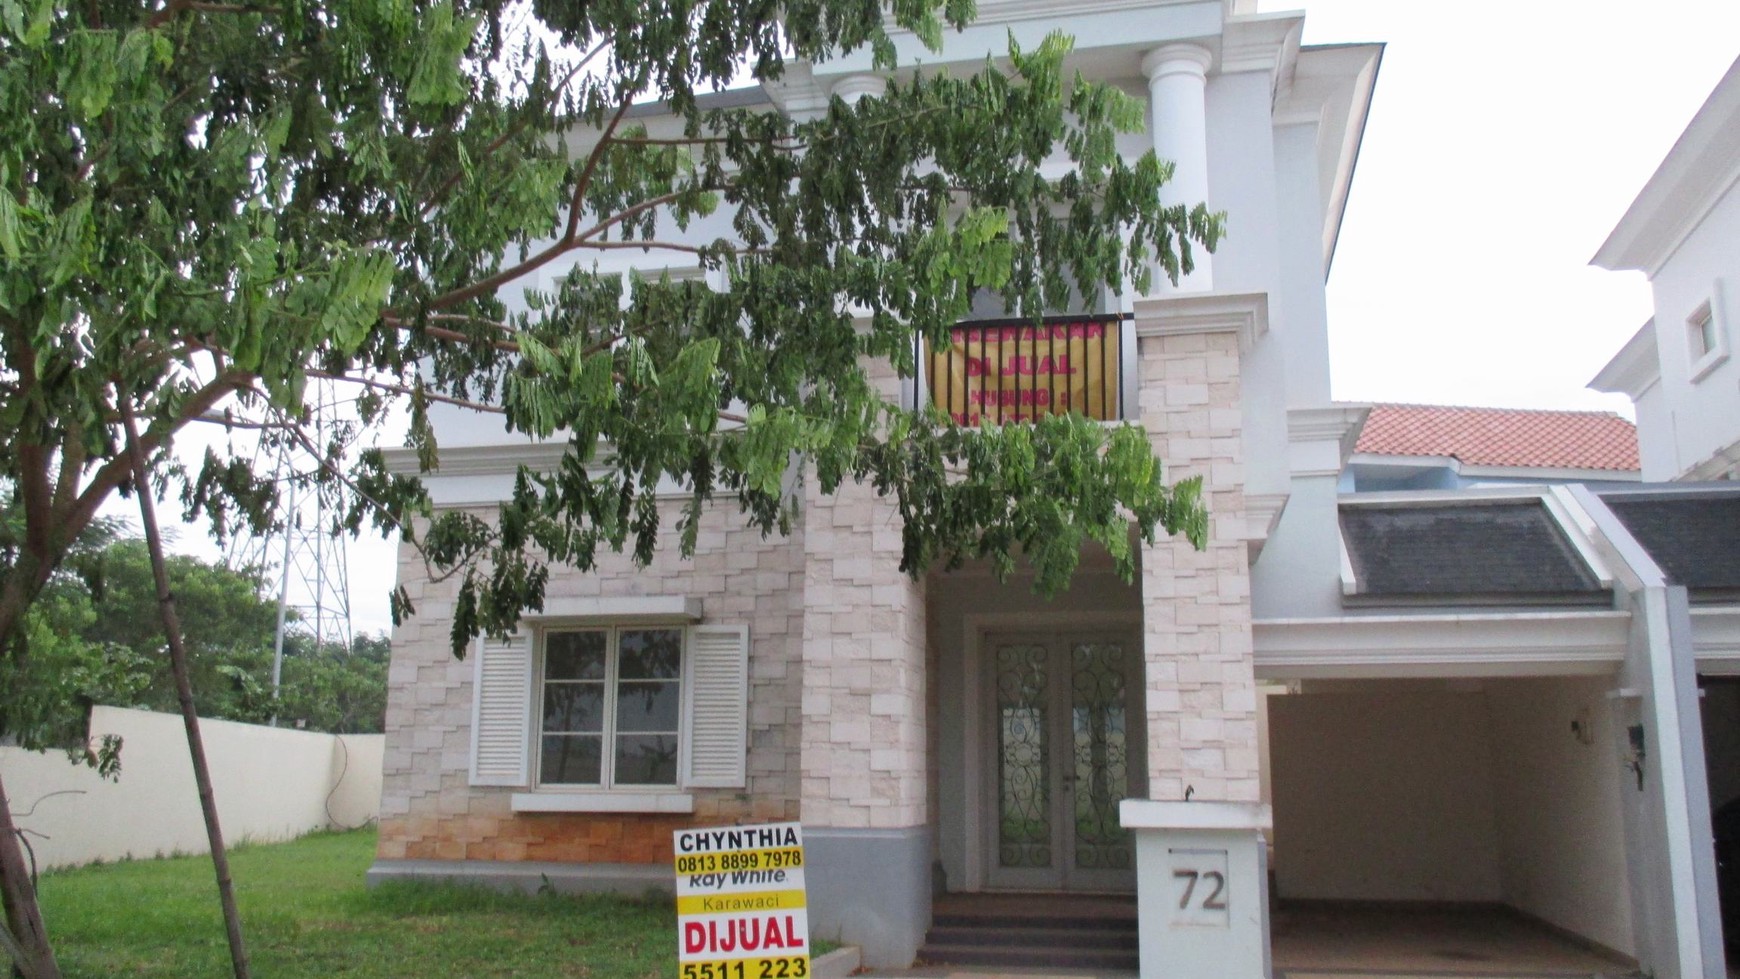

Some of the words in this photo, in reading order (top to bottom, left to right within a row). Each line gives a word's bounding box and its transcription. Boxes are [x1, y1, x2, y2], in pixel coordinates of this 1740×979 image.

[967, 357, 991, 376] DI
[1001, 354, 1076, 375] JUAL
[680, 827, 798, 851] CHYNTHIA
[678, 856, 716, 873] 0813
[721, 852, 759, 870] 8899
[763, 850, 802, 867] 7978
[689, 872, 727, 889] Ray
[731, 869, 786, 885] White
[1173, 870, 1226, 909] 72
[703, 894, 780, 911] Karawaci
[685, 915, 804, 954] DIJUAL
[684, 961, 744, 979] 5511
[759, 957, 807, 979] 223
